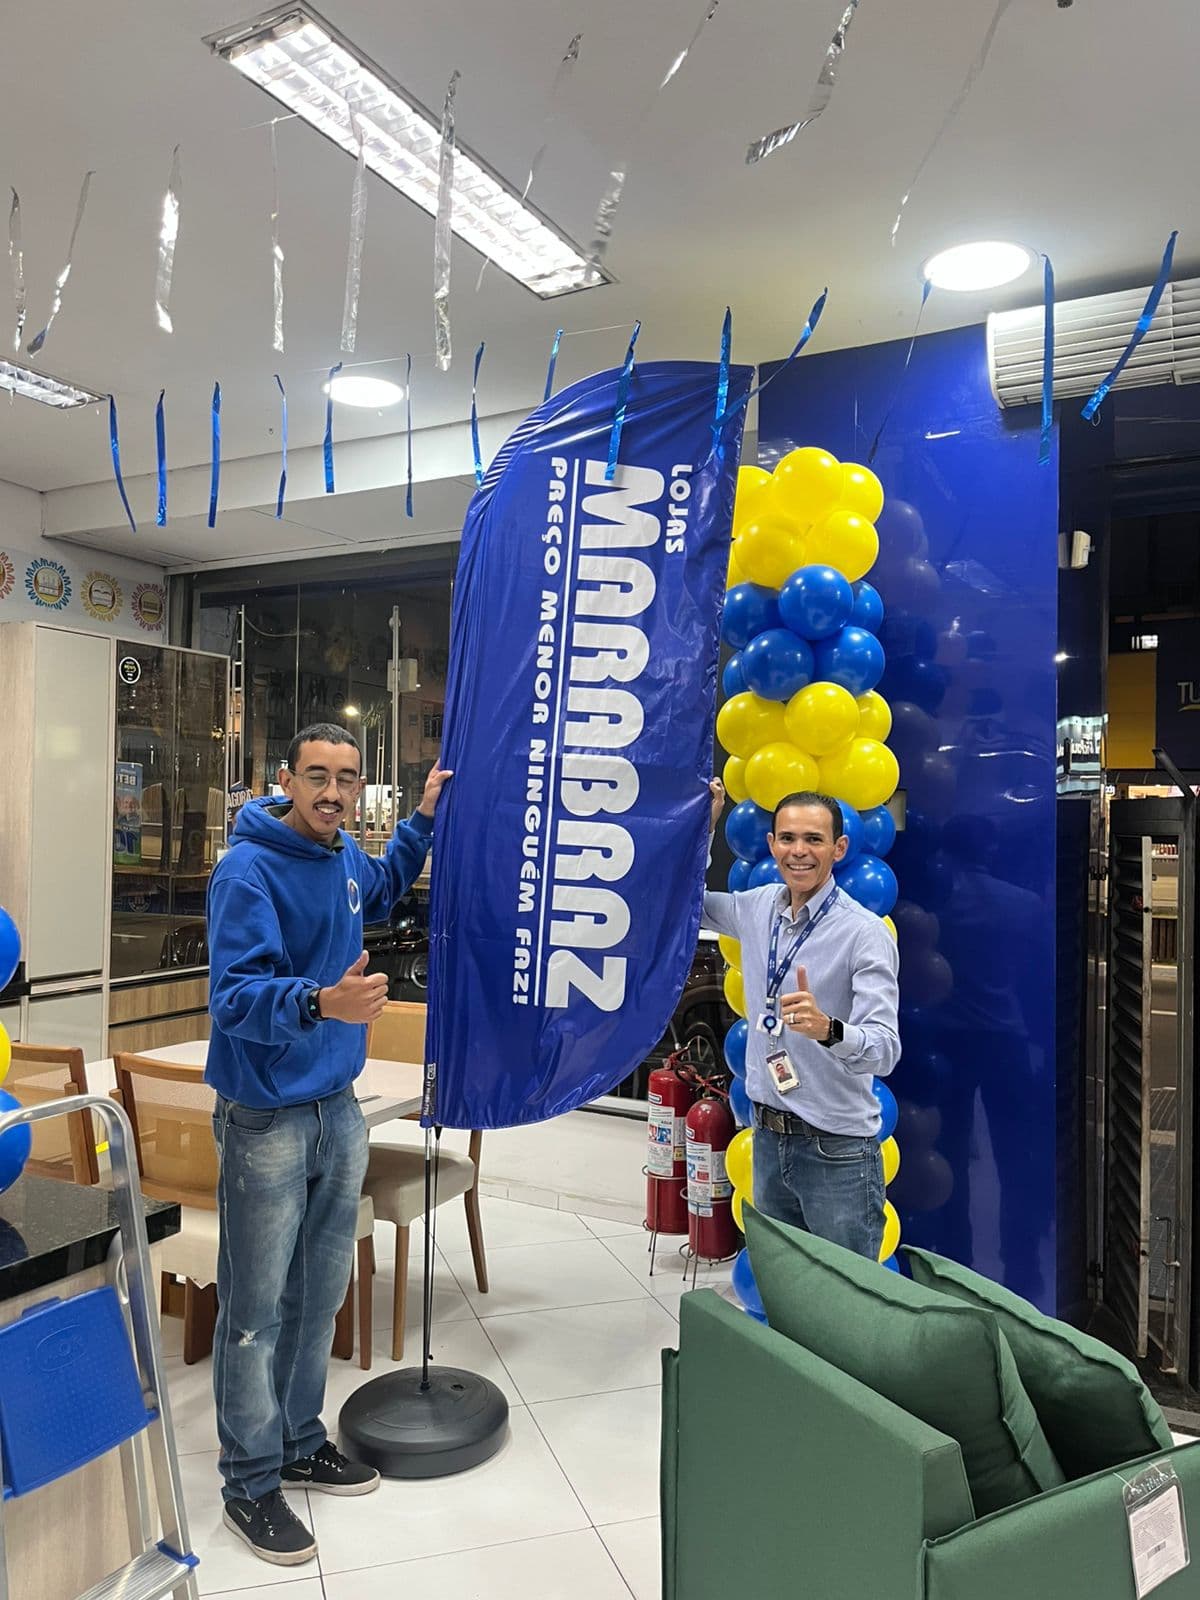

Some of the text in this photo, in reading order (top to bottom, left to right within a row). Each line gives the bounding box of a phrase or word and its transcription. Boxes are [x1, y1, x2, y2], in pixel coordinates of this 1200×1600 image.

[512, 457, 568, 1006] PREÇO MENOR NINGUÉM FAZ!
[545, 459, 665, 1012] MARABRAZ
[665, 464, 693, 554] LOJAS
